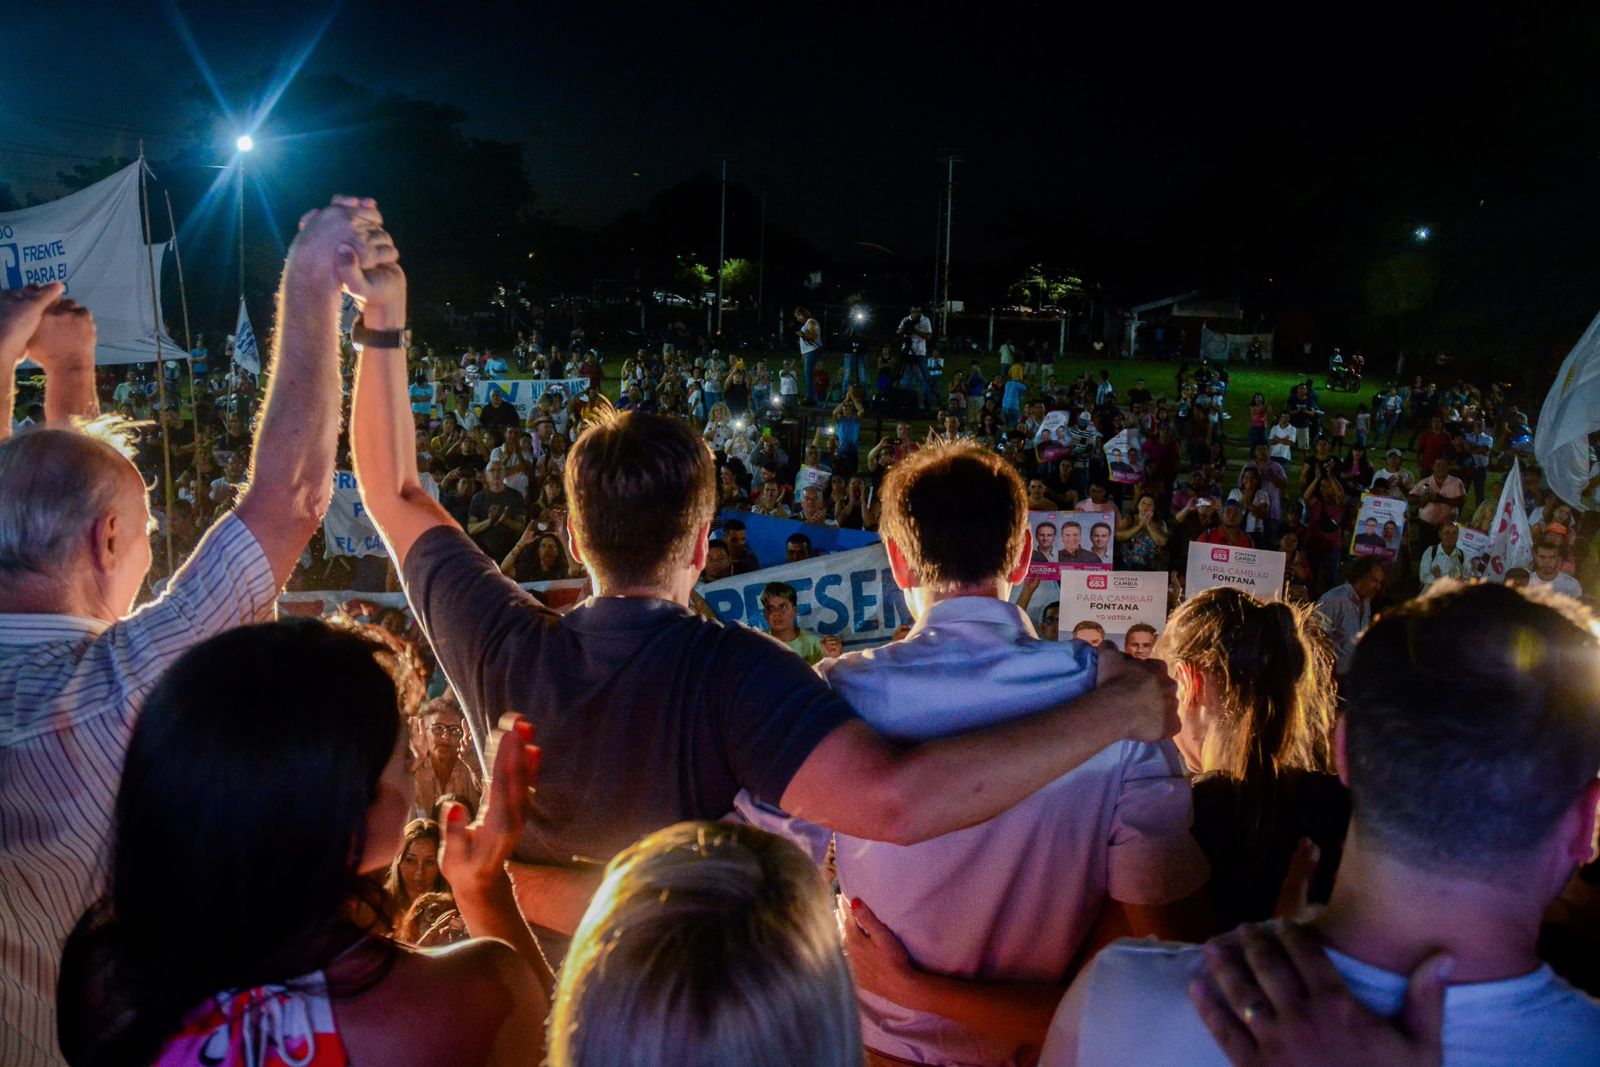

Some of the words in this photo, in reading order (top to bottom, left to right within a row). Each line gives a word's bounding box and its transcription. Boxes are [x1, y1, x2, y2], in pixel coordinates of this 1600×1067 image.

[23, 240, 65, 263] FRENTE
[26, 266, 56, 286] PARA
[1201, 564, 1225, 574] PARA
[1228, 567, 1269, 579] CAMBIAR
[1212, 574, 1256, 585] FONTANA
[1107, 595, 1153, 603] CAMBIAR
[1090, 602, 1139, 611] FONTANA
